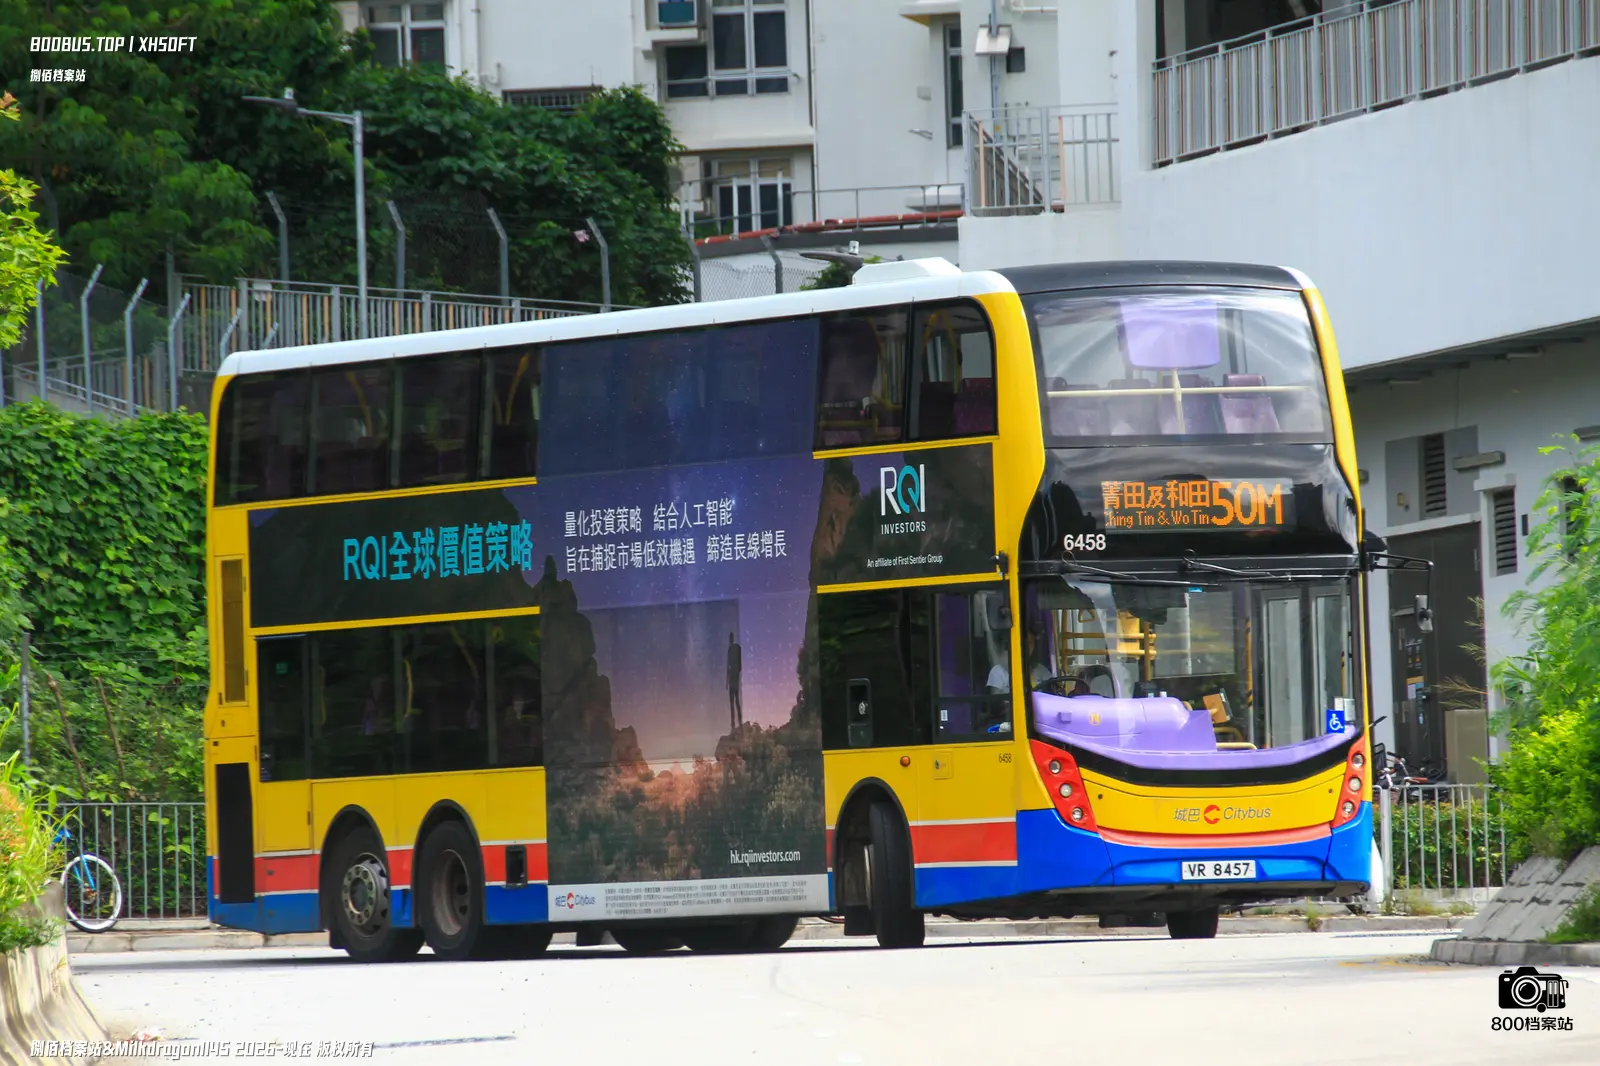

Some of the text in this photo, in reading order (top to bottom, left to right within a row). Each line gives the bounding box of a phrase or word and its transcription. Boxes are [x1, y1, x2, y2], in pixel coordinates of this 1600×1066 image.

[880, 464, 926, 516] RQI
[1211, 481, 1284, 526] 50M
[564, 498, 733, 538] 量化投資策略 結合人工智能
[1136, 510, 1155, 526] Tin
[1171, 510, 1190, 525] Wo
[1191, 509, 1209, 525] Tin
[881, 521, 926, 535] INVESTORS
[343, 519, 534, 581] RQI全球價值策略
[1063, 533, 1107, 551] 6458
[565, 530, 787, 573] 旨在捕捉市場低效機遇 締造長線增長
[867, 553, 943, 568] An affiliate of First Sentier Group
[998, 752, 1012, 763] 6458
[1173, 807, 1201, 822] 城巴
[1223, 807, 1271, 821] Citybus
[730, 850, 801, 867] hk.rqiinvestors.com
[1188, 862, 1250, 877] VR 8457
